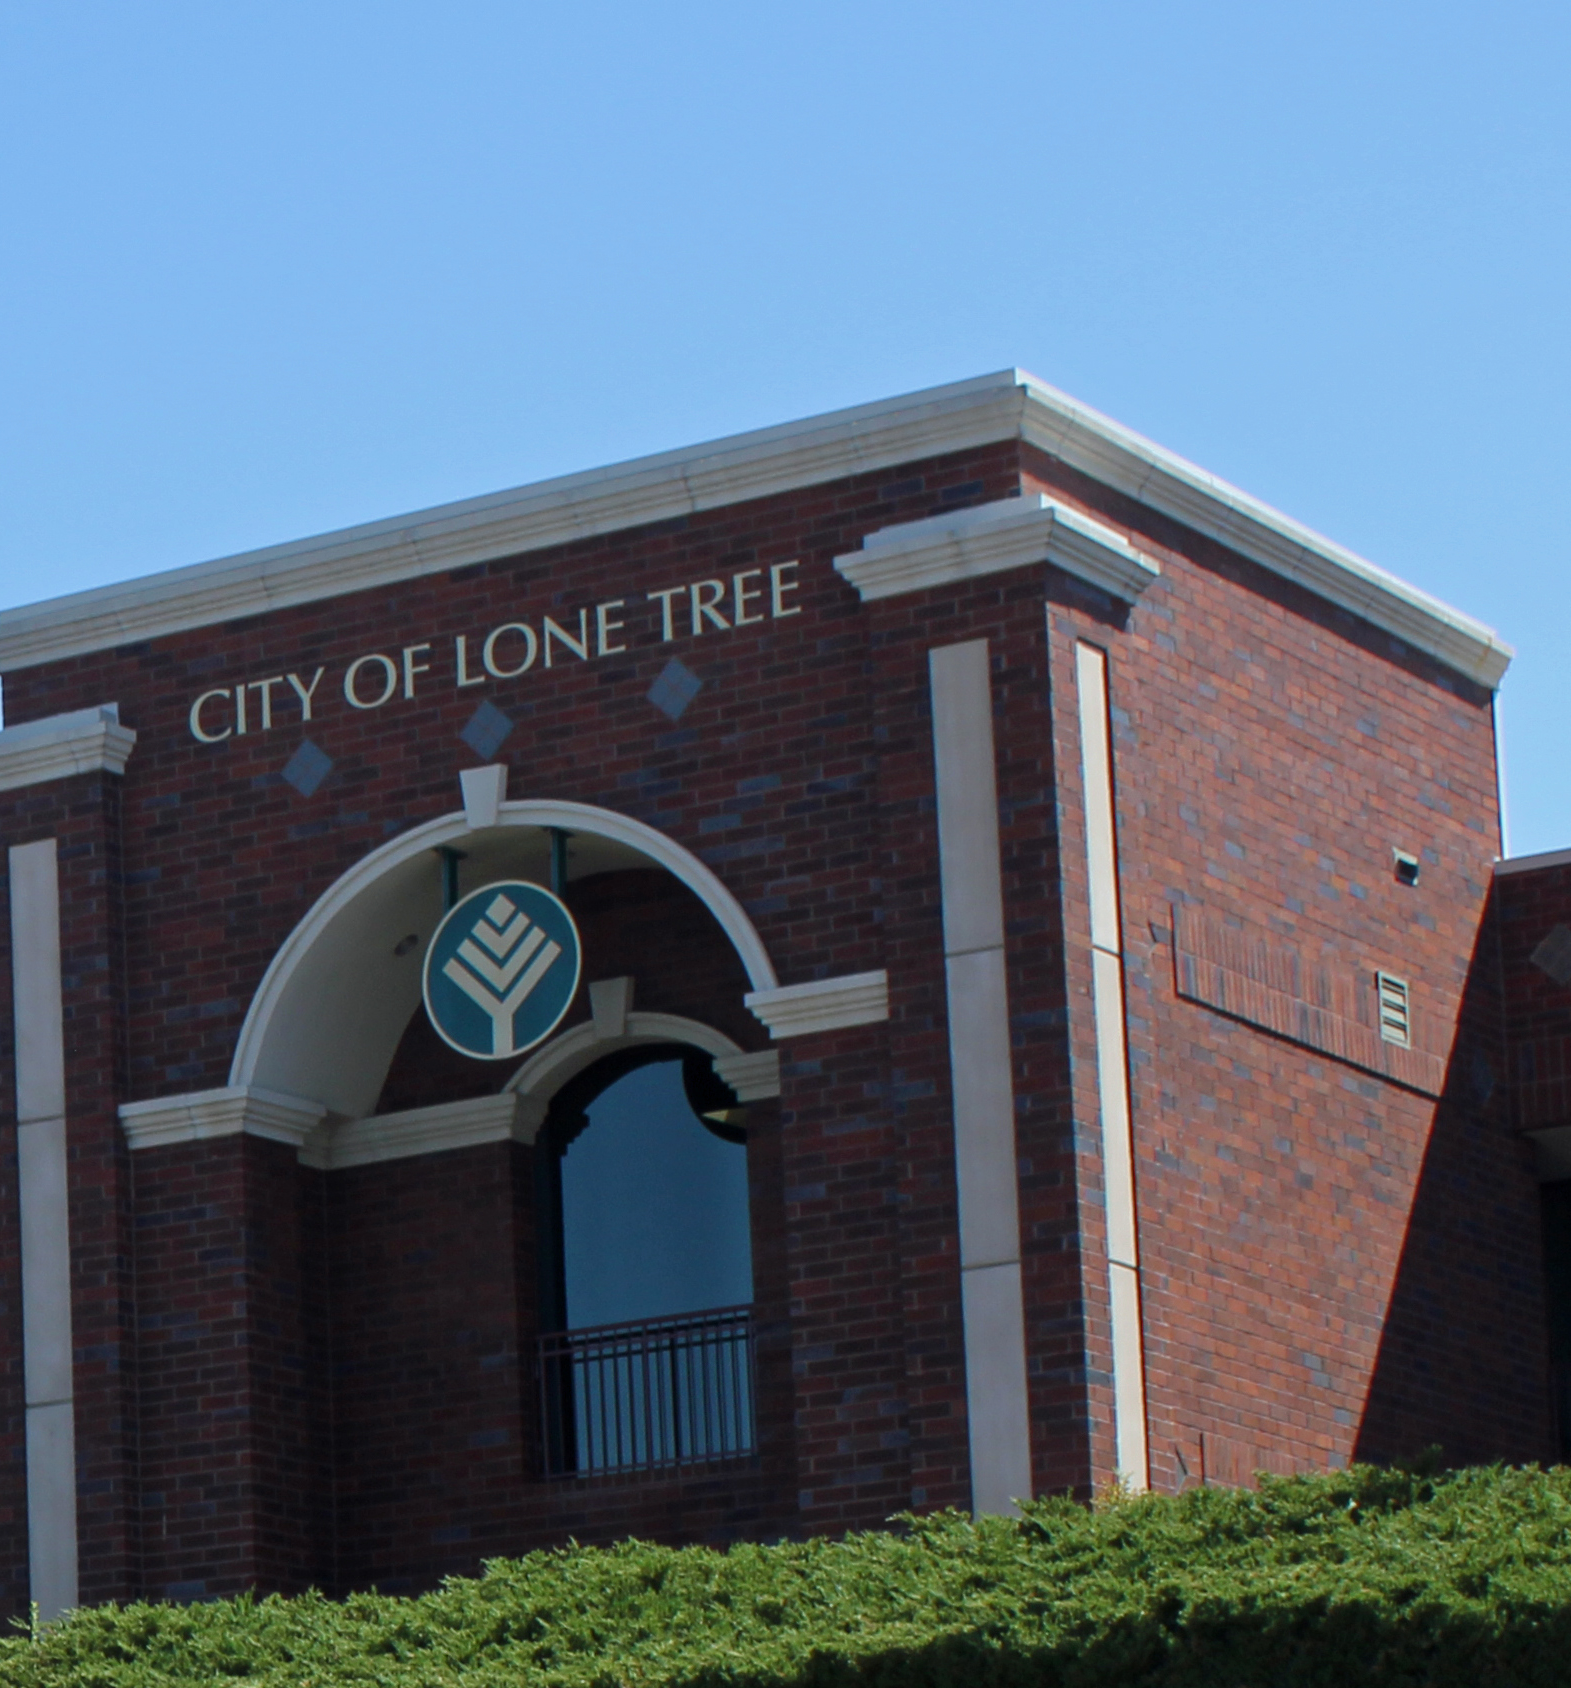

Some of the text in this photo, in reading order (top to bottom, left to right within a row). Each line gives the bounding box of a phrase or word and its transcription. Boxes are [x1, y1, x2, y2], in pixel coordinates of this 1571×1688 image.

[188, 560, 802, 744] CITY OF LONE TREE
